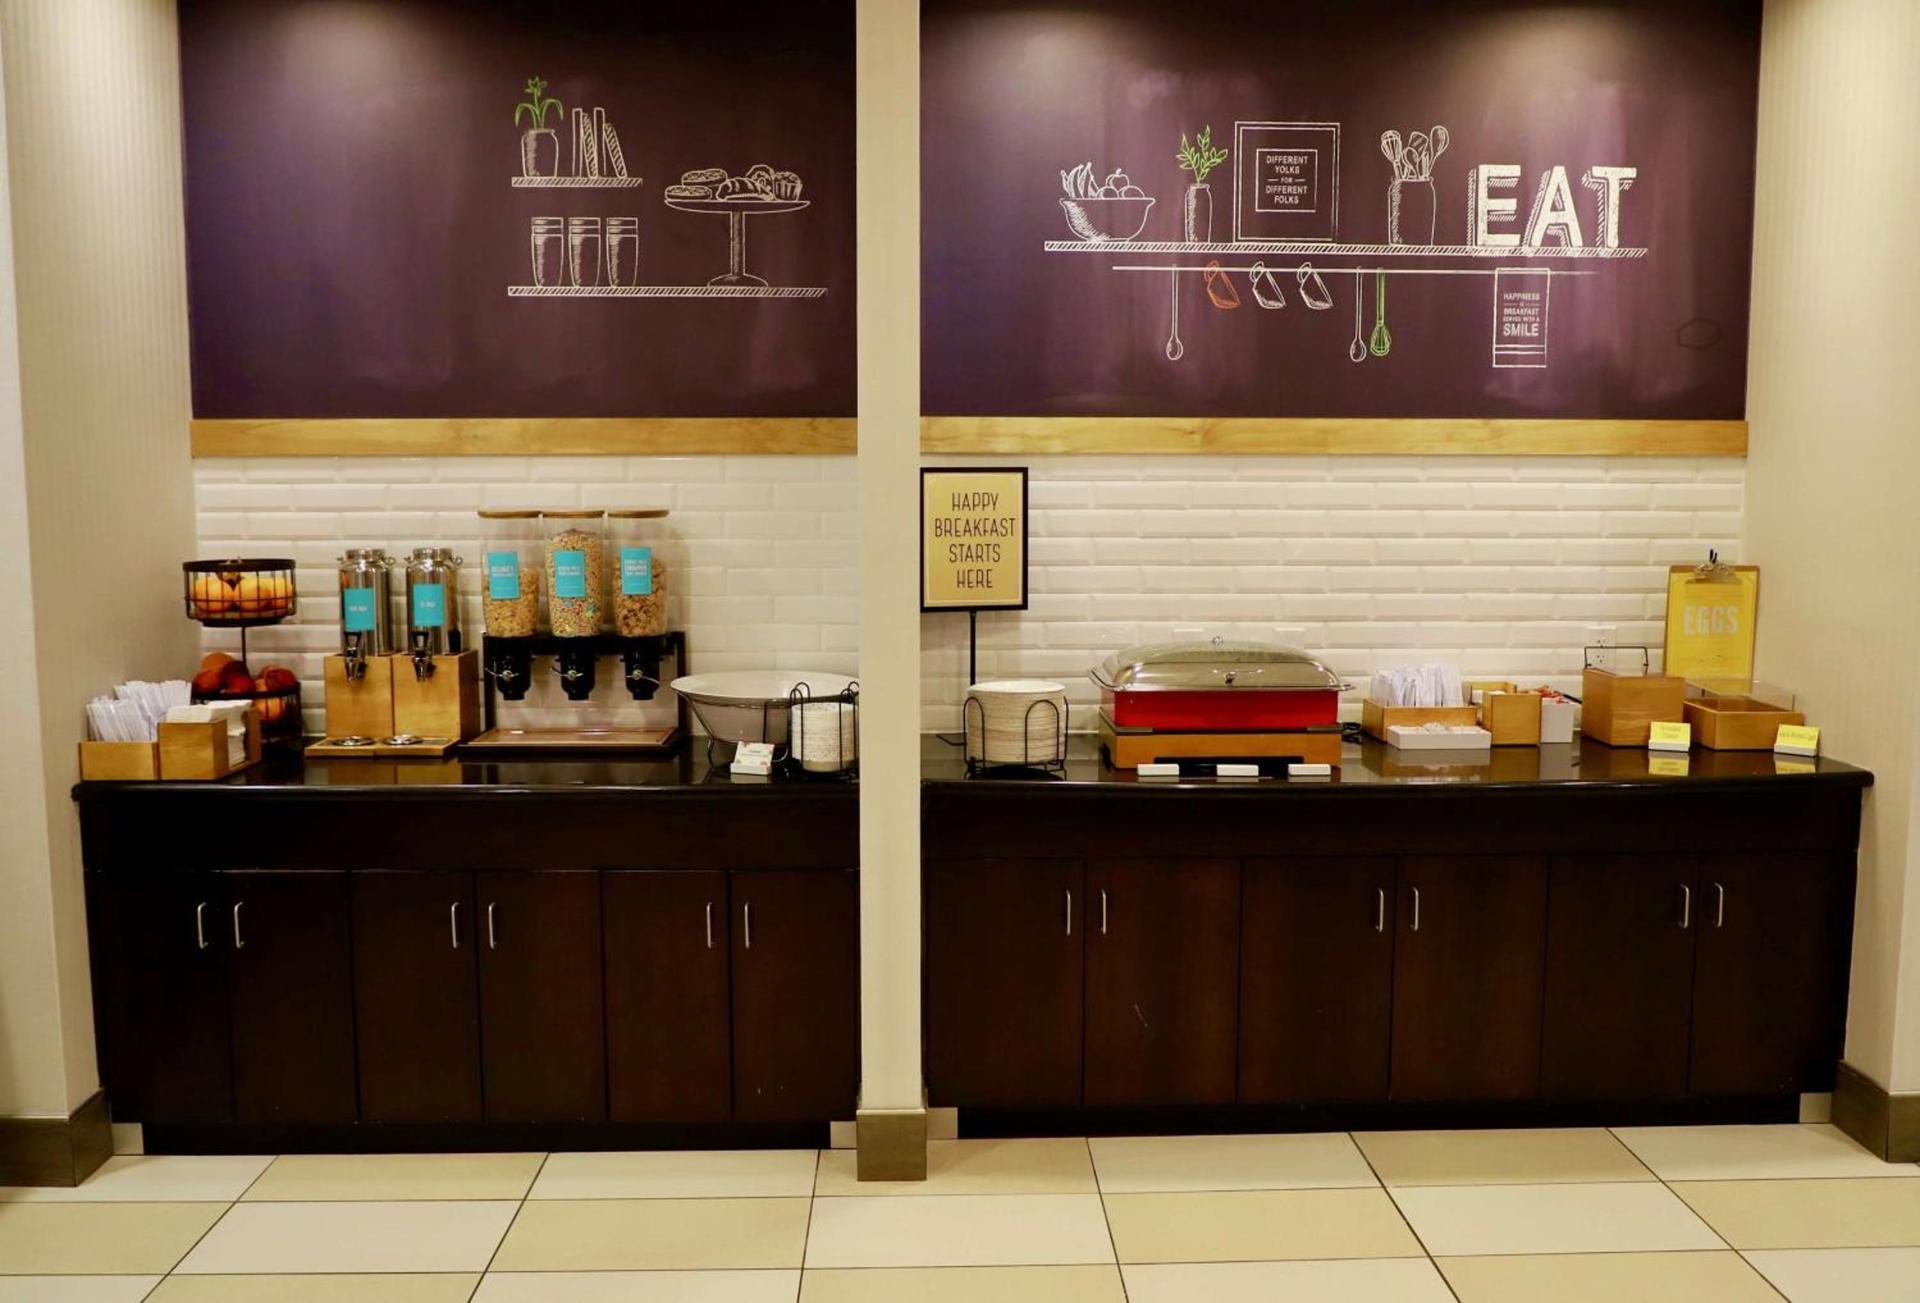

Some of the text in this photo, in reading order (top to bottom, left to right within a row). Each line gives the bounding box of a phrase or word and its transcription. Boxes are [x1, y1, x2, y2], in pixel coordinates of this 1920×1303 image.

[1266, 155, 1308, 164] DIFFERENT
[1275, 165, 1300, 174] YOLKS
[1265, 185, 1308, 194] DIFFERENT
[1274, 195, 1299, 204] FOLKS
[1468, 164, 1637, 248] EAT
[1503, 323, 1540, 336] SMILE
[951, 492, 999, 511] HAPPY
[934, 518, 1016, 537] BREAKFAST
[948, 543, 1001, 563] STARTS
[956, 568, 994, 588] HERE
[1683, 605, 1739, 637] EGGS
